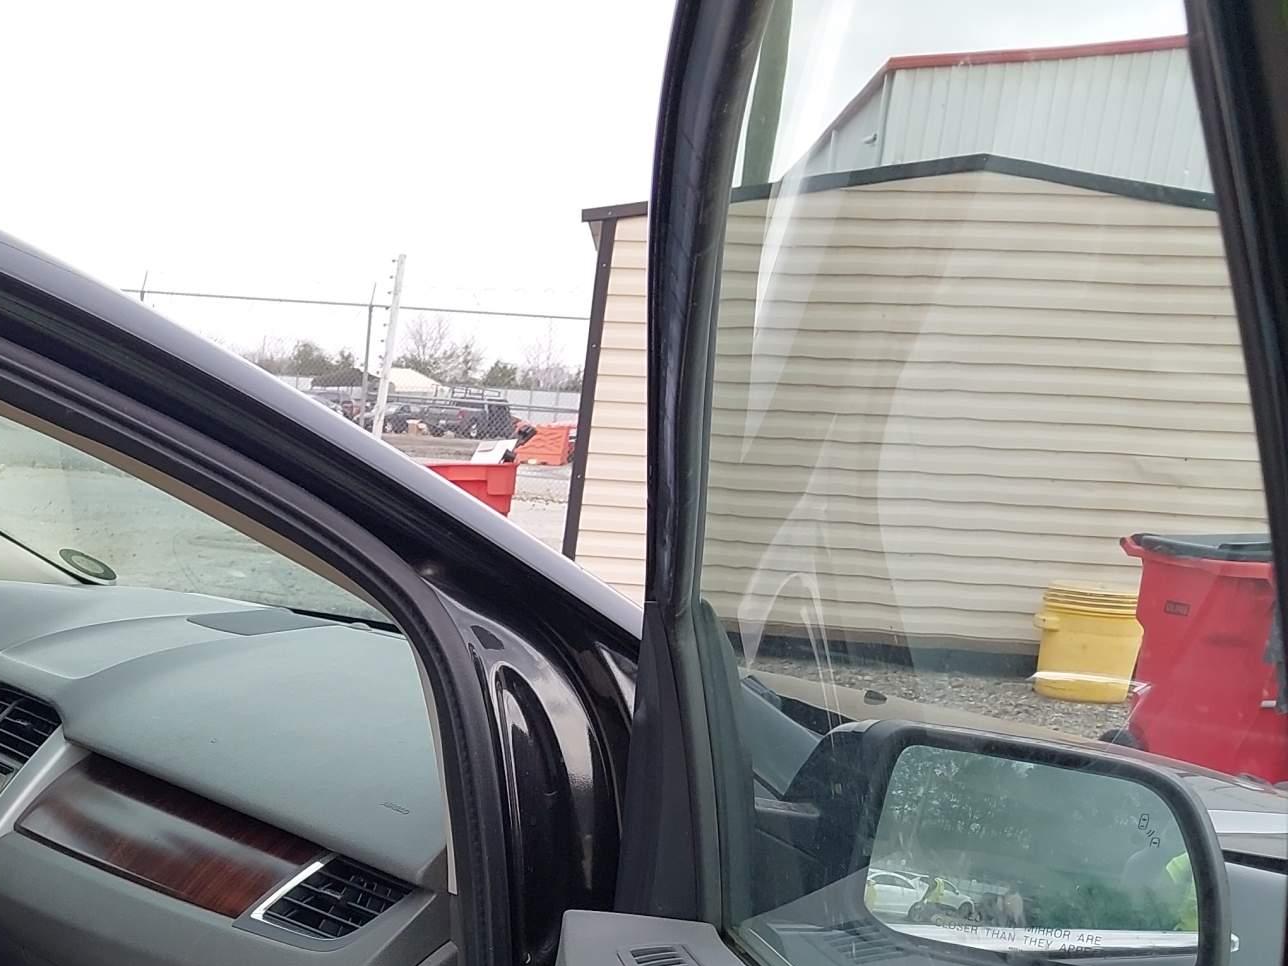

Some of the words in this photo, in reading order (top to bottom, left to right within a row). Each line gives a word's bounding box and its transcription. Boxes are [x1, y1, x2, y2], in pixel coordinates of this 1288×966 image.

[935, 917, 978, 934] CLOSER
[985, 927, 1017, 943] THAN
[1023, 935, 1053, 949] THEY
[1077, 933, 1103, 946] ARE
